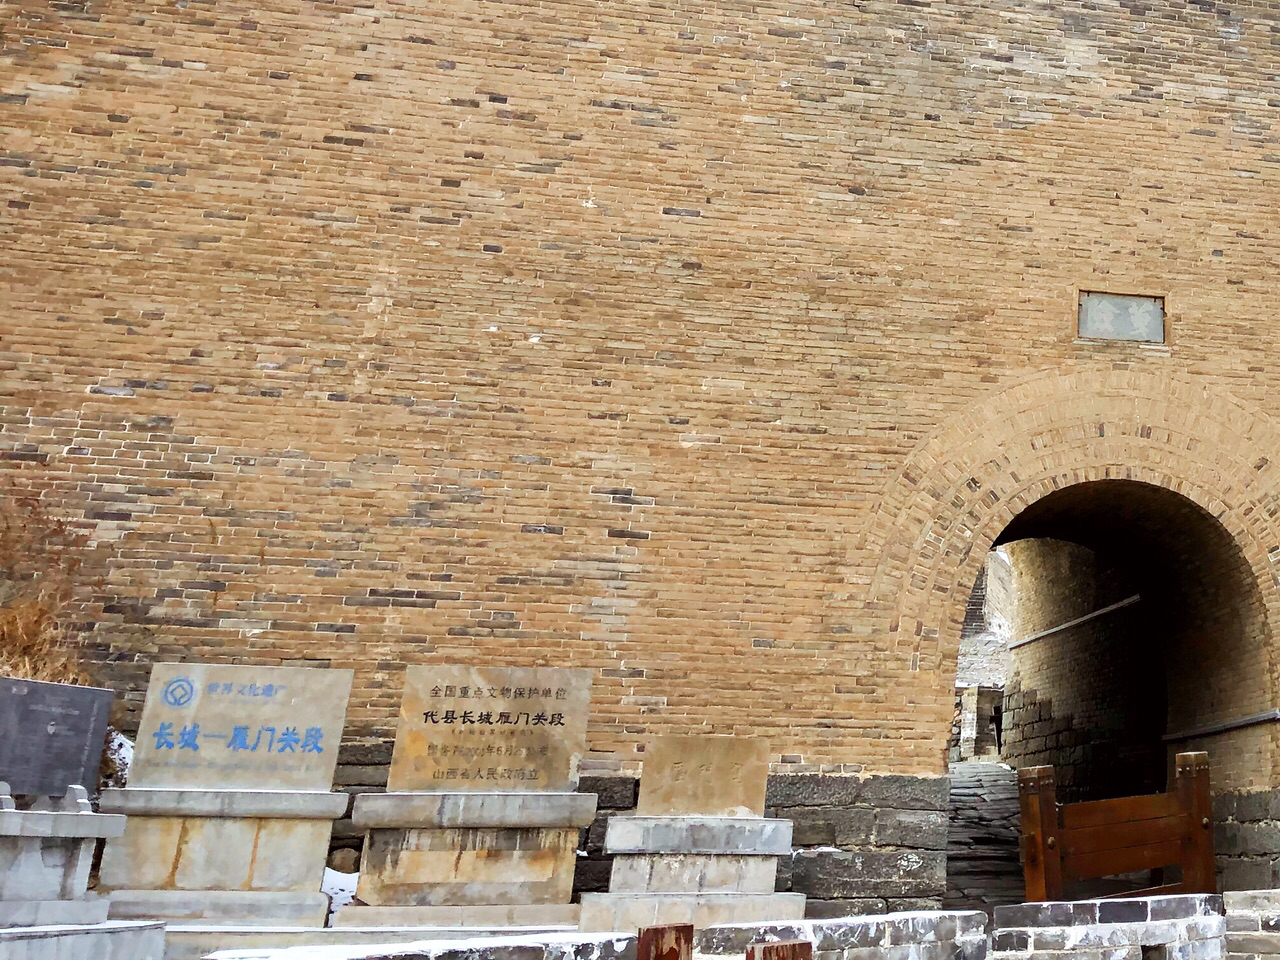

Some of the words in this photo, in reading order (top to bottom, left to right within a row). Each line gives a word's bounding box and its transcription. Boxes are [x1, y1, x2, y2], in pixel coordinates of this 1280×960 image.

[430, 685, 567, 700] 全国重点文物保护单位
[422, 710, 566, 727] 代县长城雁门关段
